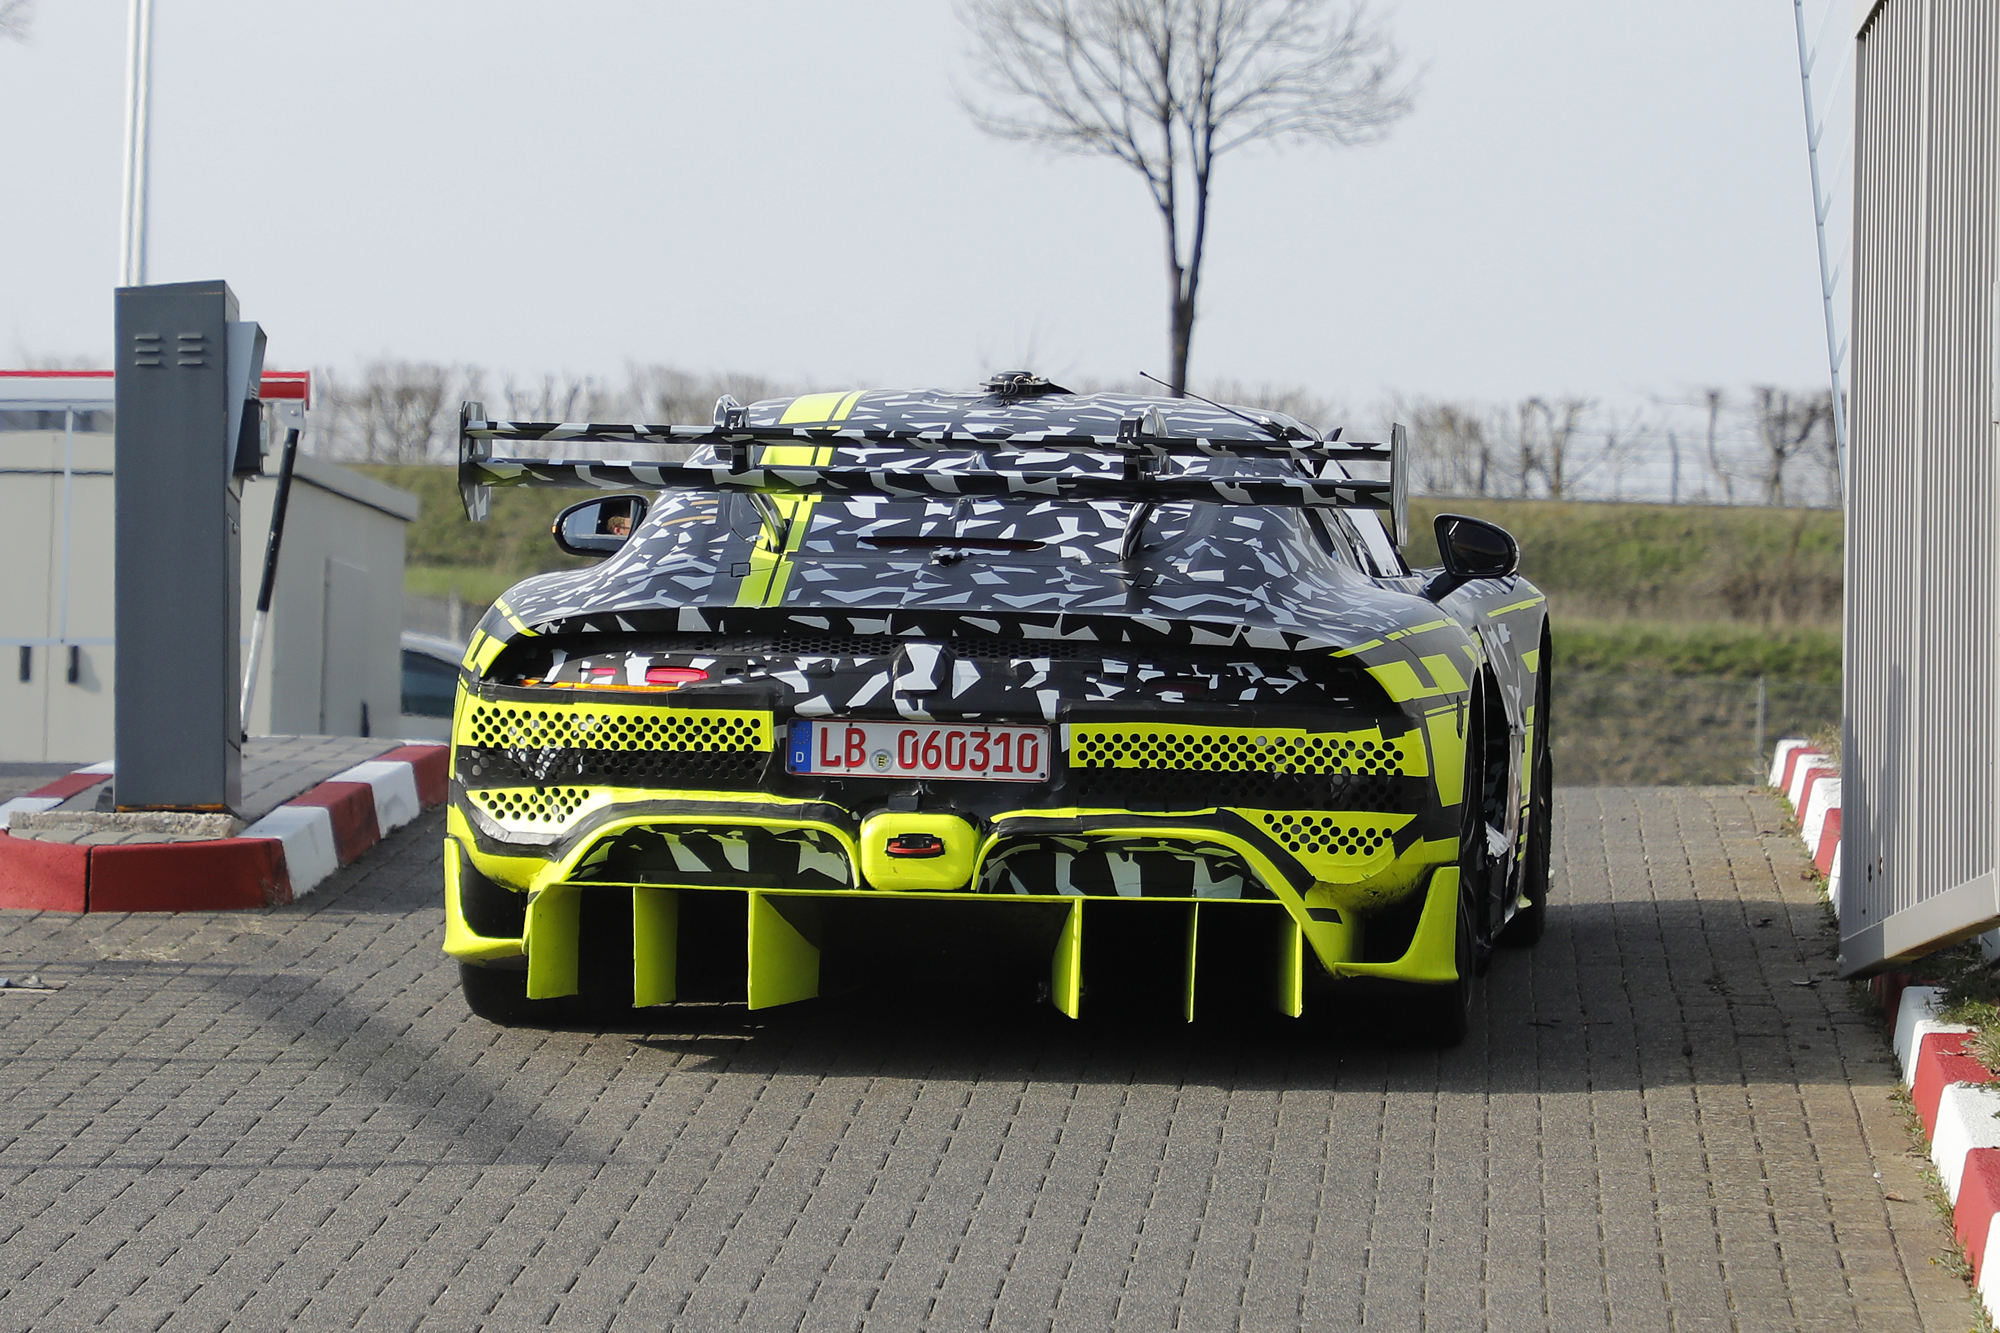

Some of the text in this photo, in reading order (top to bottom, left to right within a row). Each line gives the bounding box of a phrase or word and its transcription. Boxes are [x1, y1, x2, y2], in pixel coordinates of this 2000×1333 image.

[795, 751, 805, 763] D
[820, 727, 1038, 773] LB 060310
